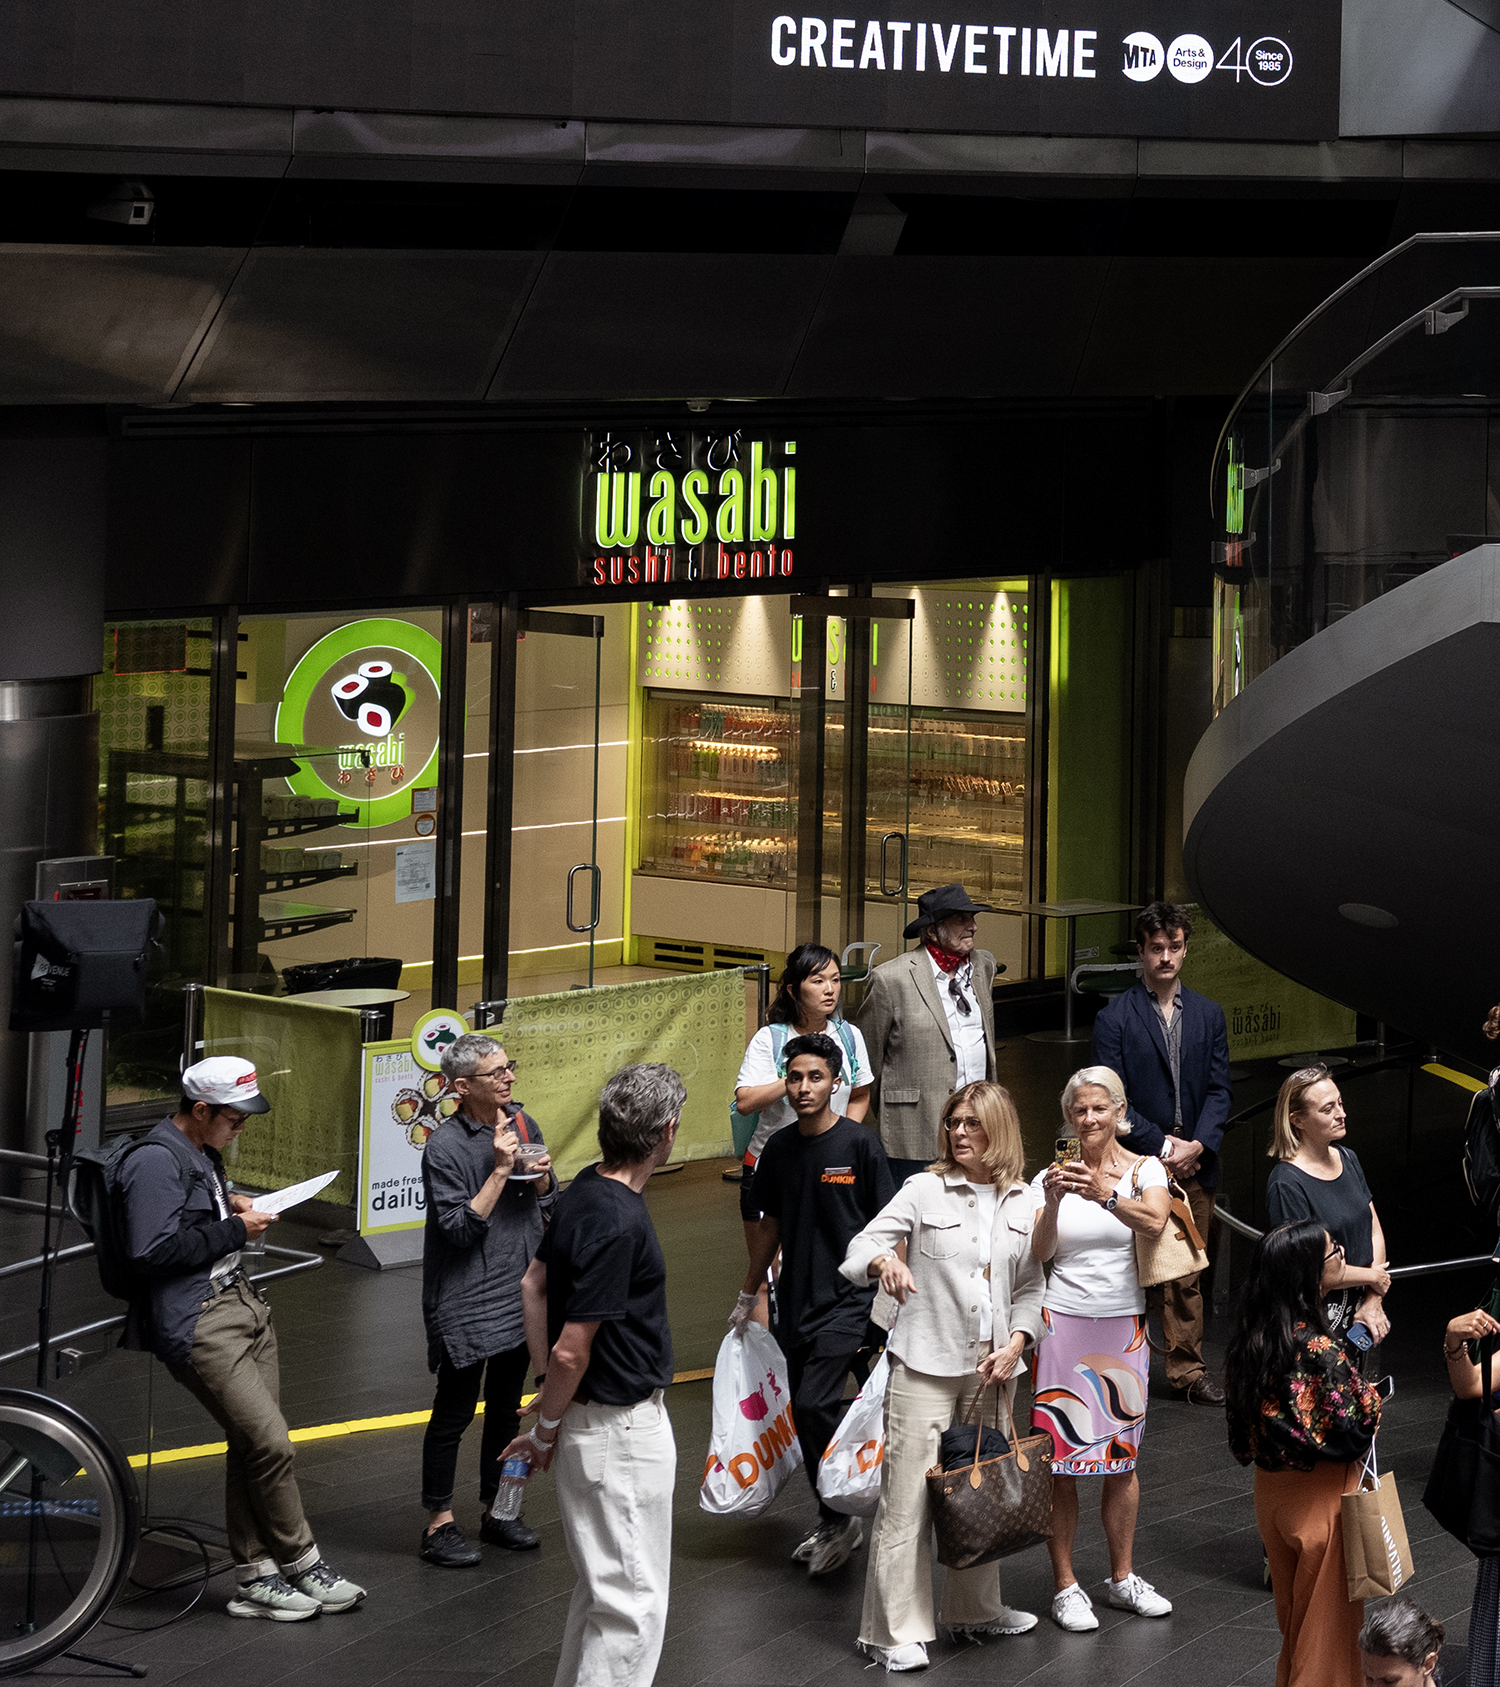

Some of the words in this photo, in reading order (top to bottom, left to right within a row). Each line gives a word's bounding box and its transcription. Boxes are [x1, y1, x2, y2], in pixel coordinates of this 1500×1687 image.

[771, 15, 1098, 79] CREATIVETIME
[1122, 43, 1158, 72] MTA
[1174, 47, 1196, 58] Arts
[1197, 47, 1206, 58] &
[1255, 50, 1284, 62] Since
[1172, 57, 1208, 71] Design
[1257, 61, 1282, 73] 1985
[594, 440, 798, 550] wasabi
[593, 544, 673, 586] sushi
[716, 541, 794, 580] bento
[338, 733, 405, 770] wasabi
[338, 765, 405, 784] わさび
[1232, 1004, 1281, 1035] wasabi
[1233, 1002, 1269, 1016] わさび
[375, 1052, 404, 1063] わさび
[375, 1056, 414, 1076] wasabi
[371, 1176, 400, 1191] made
[402, 1174, 425, 1187] fres
[371, 1186, 427, 1212] daily
